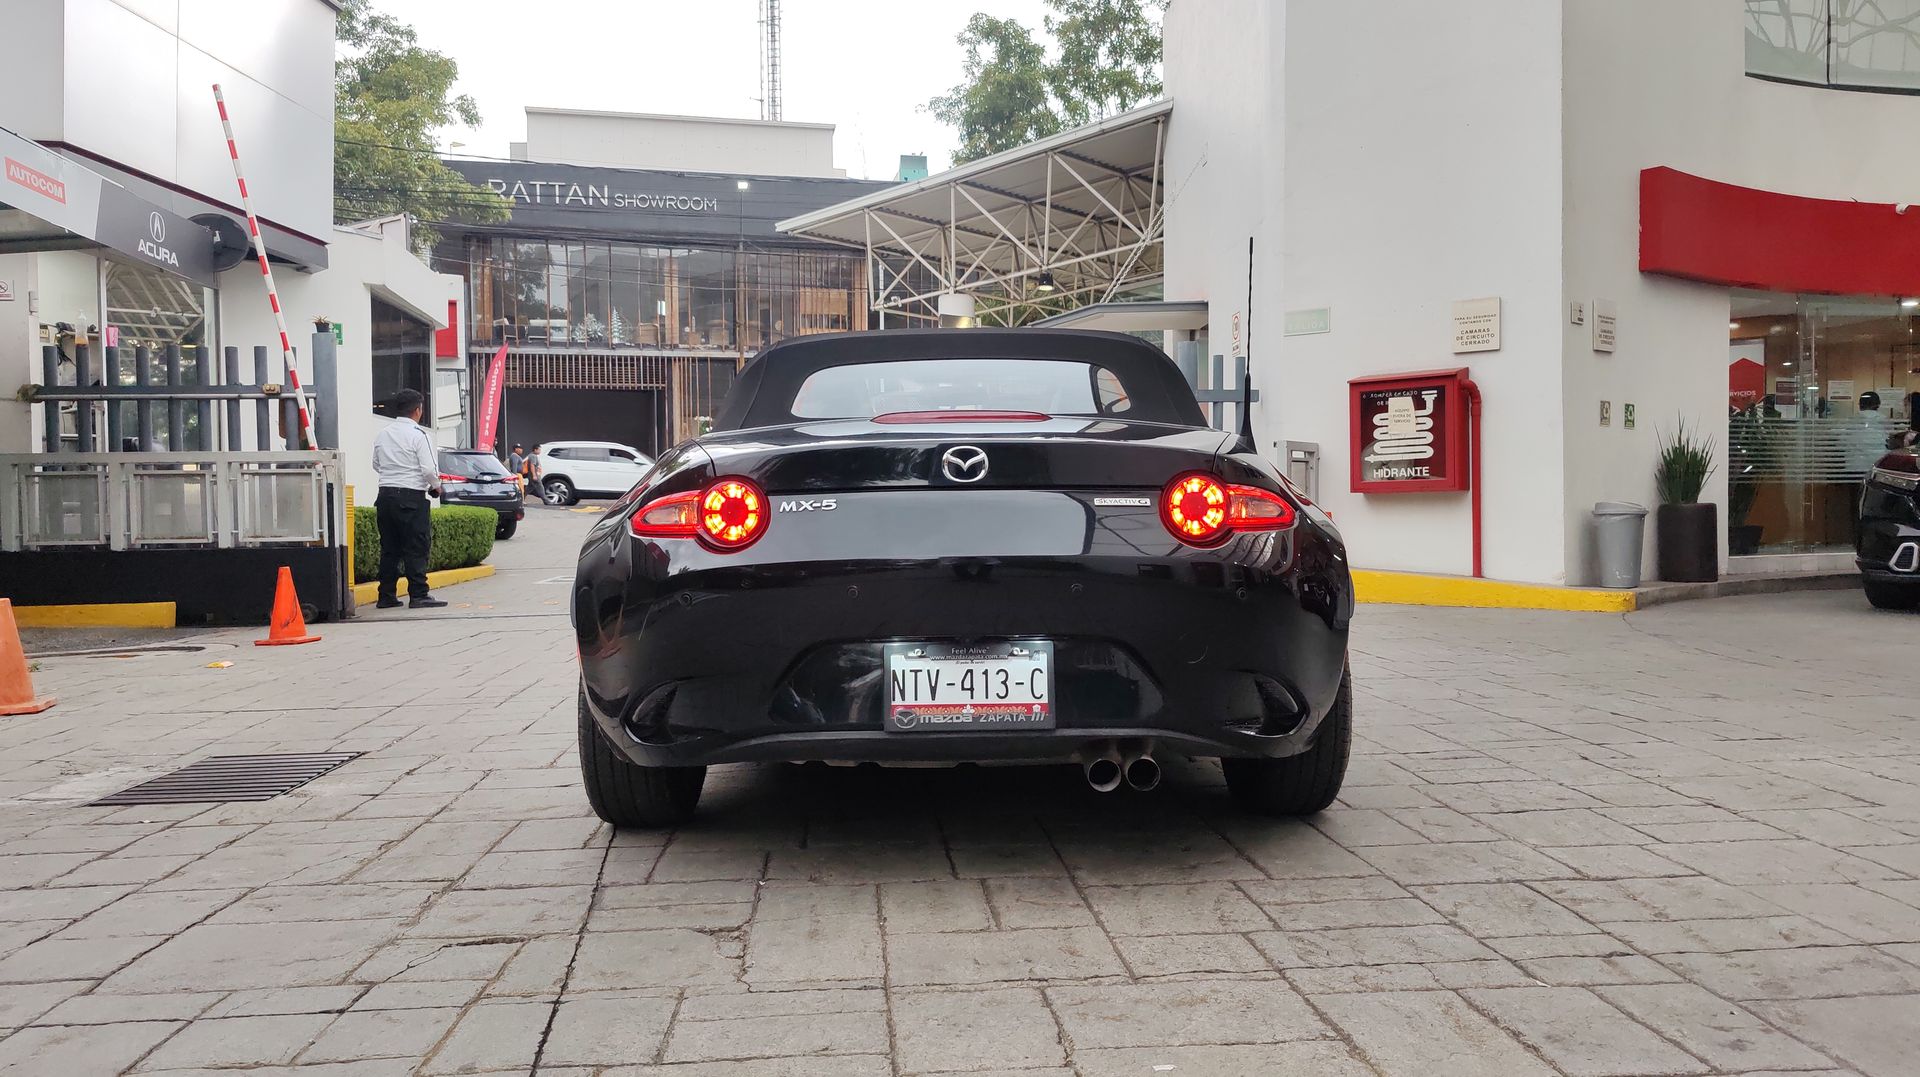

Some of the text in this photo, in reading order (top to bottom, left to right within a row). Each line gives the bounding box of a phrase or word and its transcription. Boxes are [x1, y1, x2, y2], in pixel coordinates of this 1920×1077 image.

[9, 164, 63, 199] AUTOCOM
[488, 179, 717, 212] RATTAN SHOWROOM
[138, 238, 179, 267] ACURA
[1373, 466, 1430, 478] HIDRANTE
[779, 499, 837, 513] MX-5
[892, 668, 1044, 701] NTV-413-C
[920, 713, 1027, 723] mazda ZAPATA
